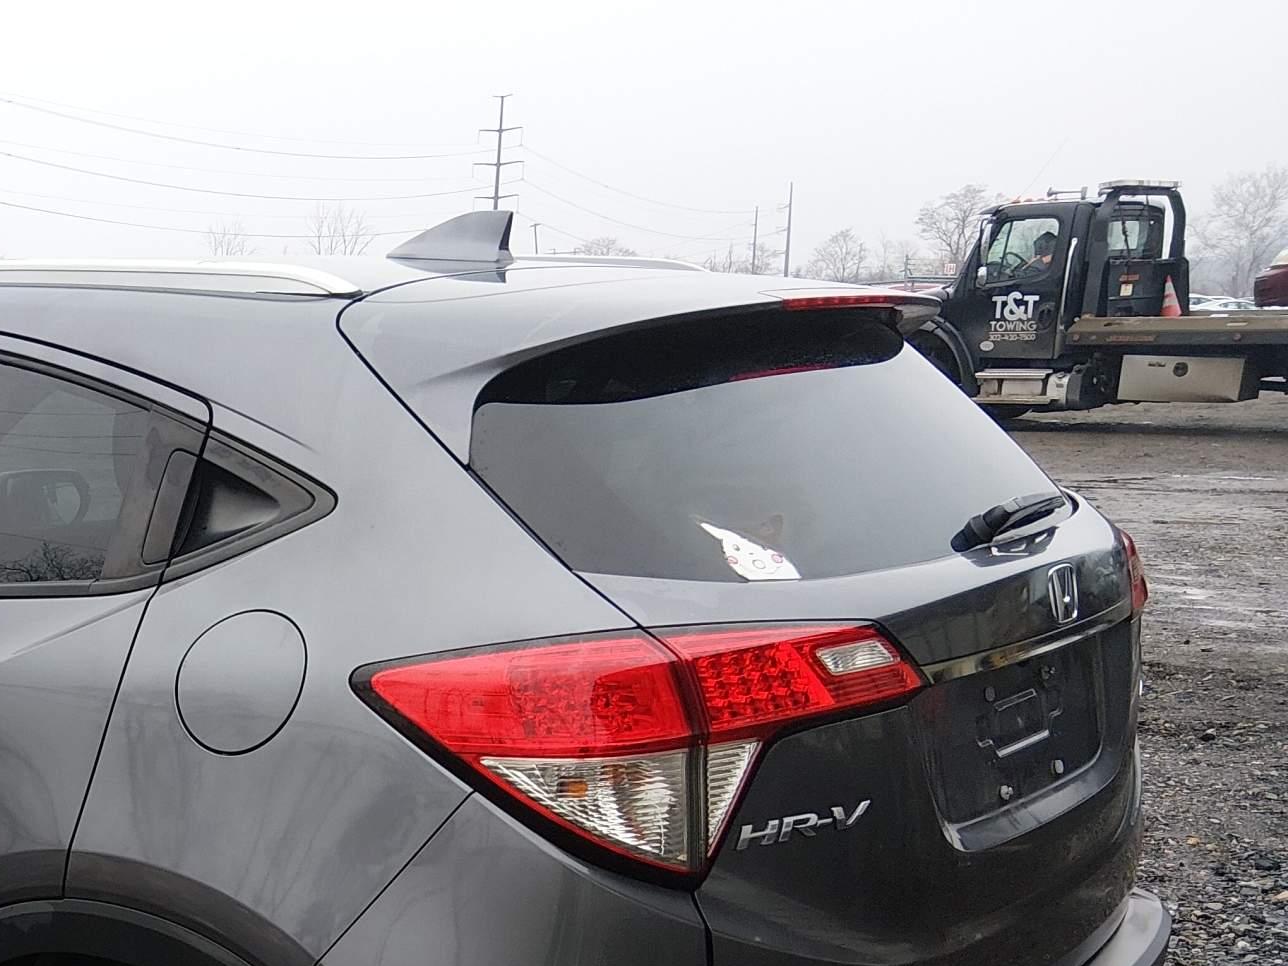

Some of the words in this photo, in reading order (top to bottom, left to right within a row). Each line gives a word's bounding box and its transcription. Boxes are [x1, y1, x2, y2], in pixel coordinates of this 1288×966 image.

[991, 291, 1040, 321] T&T
[990, 320, 1037, 332] TOWING
[736, 799, 871, 850] HR-V
